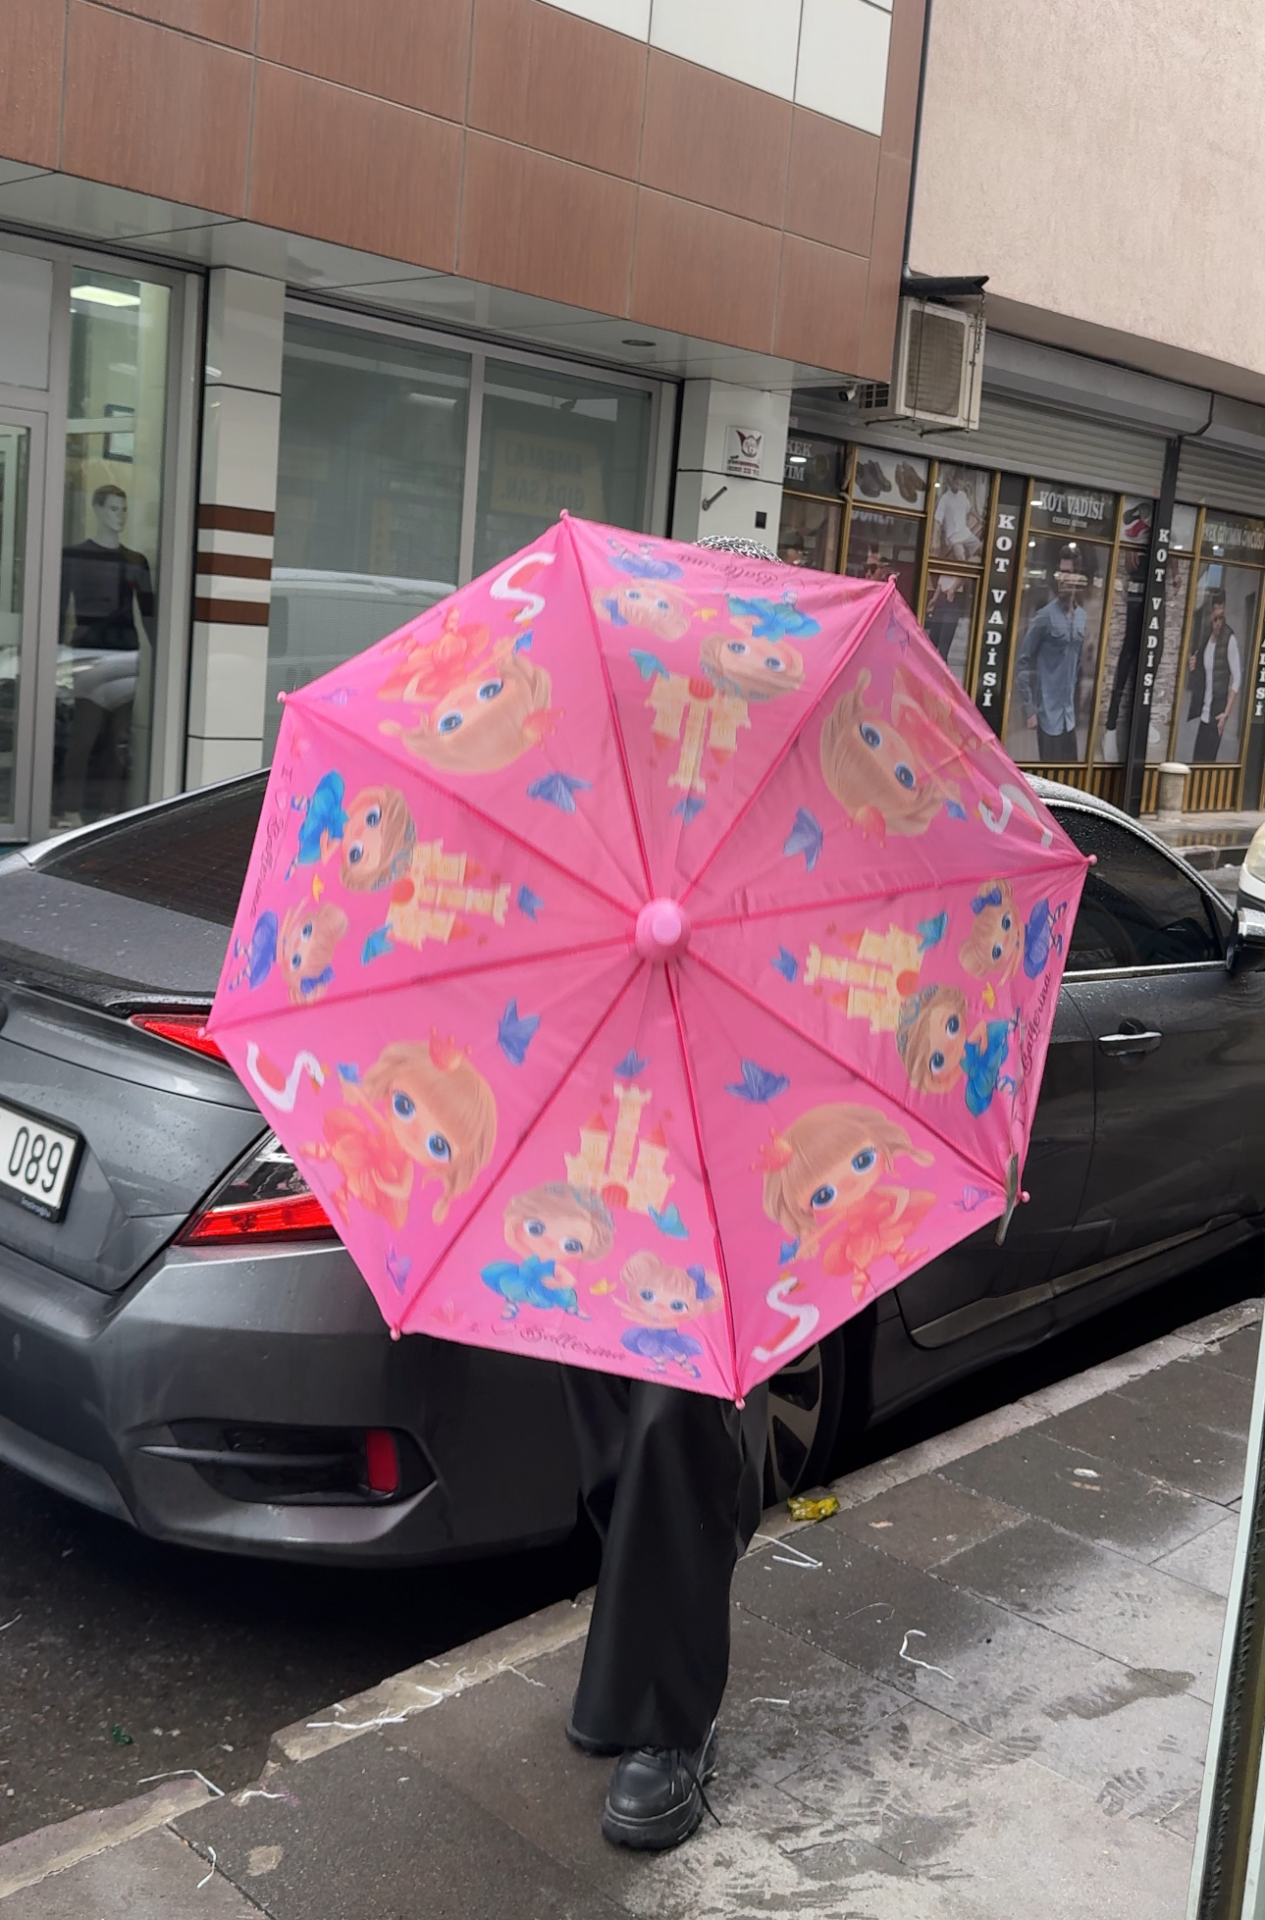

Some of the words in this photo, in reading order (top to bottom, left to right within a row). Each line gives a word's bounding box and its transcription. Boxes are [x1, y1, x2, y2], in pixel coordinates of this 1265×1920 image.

[1039, 490, 1065, 513] KOT
[1067, 495, 1105, 520] VADİSİ
[994, 514, 1016, 573] KOT
[1154, 528, 1170, 583] KOT
[982, 588, 1008, 707] VADİSİ
[1142, 597, 1163, 705] VADİSİ
[8, 1126, 64, 1193] 089
